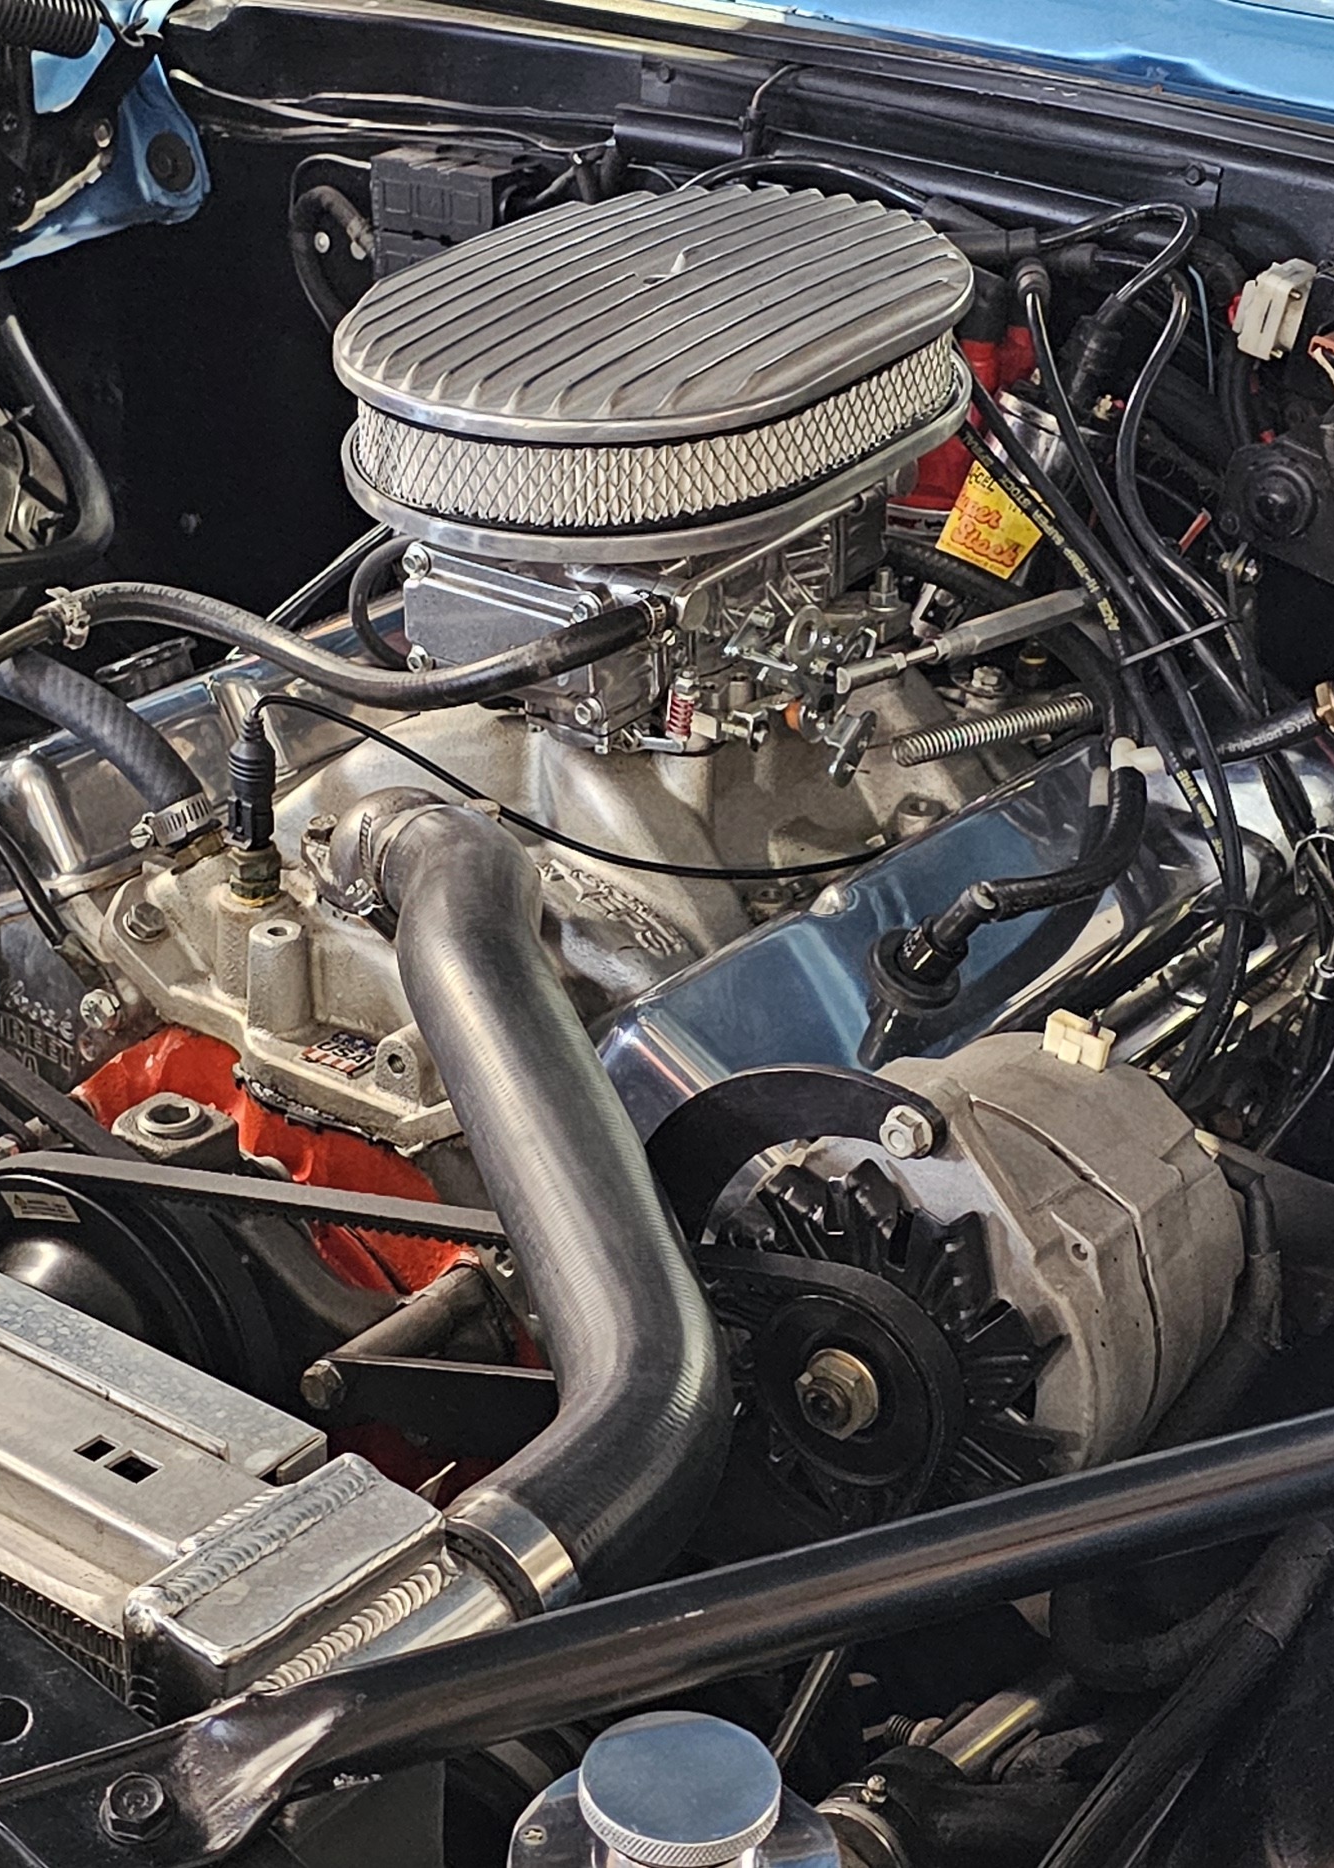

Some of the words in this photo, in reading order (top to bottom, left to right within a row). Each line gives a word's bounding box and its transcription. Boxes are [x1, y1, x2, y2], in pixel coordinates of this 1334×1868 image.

[1000, 473, 1032, 510] STOCK
[951, 519, 1022, 568] Stock
[1033, 510, 1065, 546] SUPER
[1175, 769, 1199, 801] WIRE
[316, 1041, 366, 1063] USA
